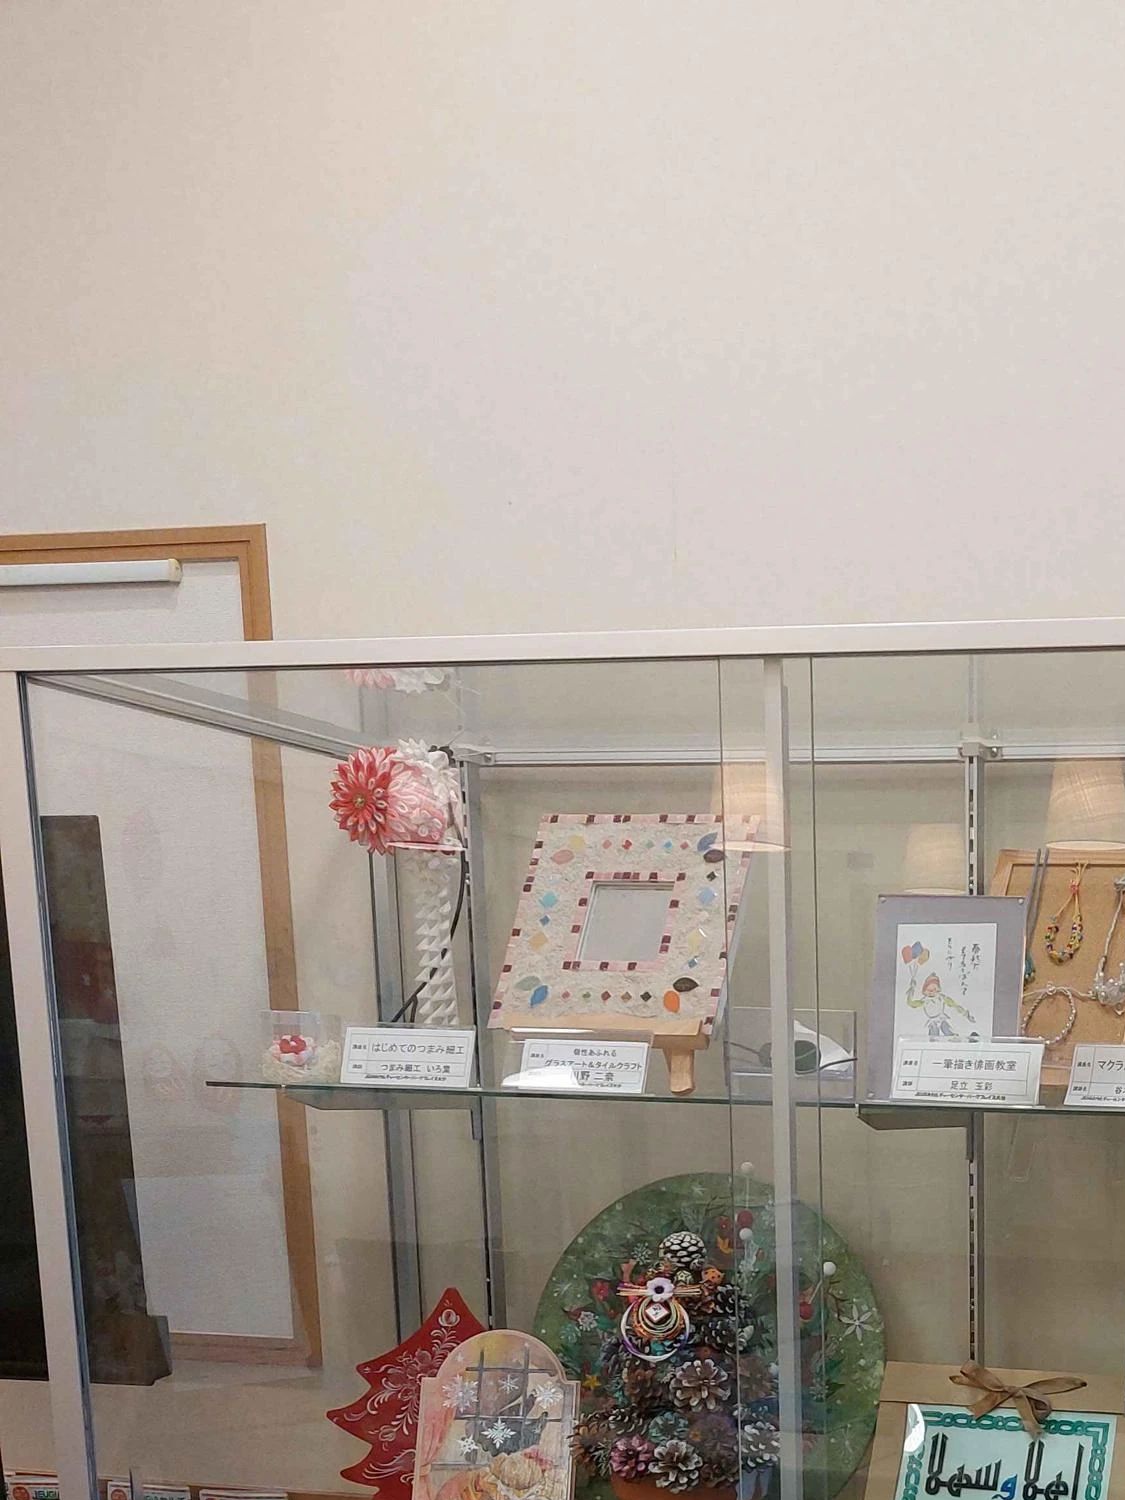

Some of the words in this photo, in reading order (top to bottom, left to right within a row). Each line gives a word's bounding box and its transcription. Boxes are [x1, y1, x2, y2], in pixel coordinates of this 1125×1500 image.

[372, 1042, 465, 1055] はじめてのつまみ細工
